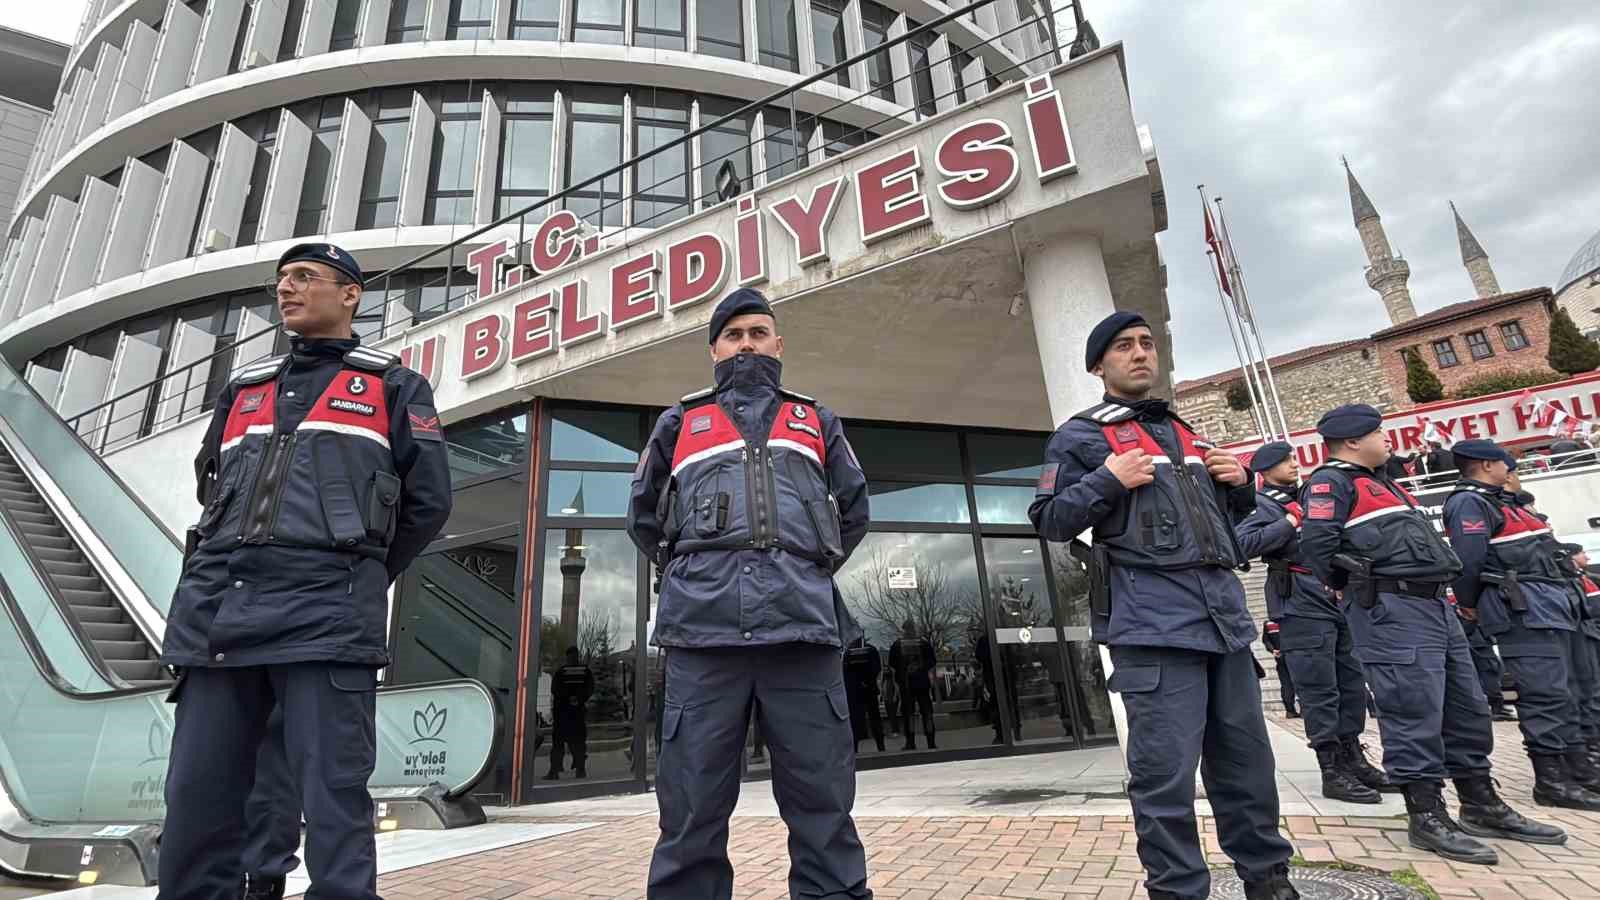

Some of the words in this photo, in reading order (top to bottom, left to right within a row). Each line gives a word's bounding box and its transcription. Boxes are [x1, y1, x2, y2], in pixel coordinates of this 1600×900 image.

[459, 74, 1078, 383] BELEDİYESİ
[467, 210, 601, 301] T.C.
[331, 399, 373, 414] JANDARMA
